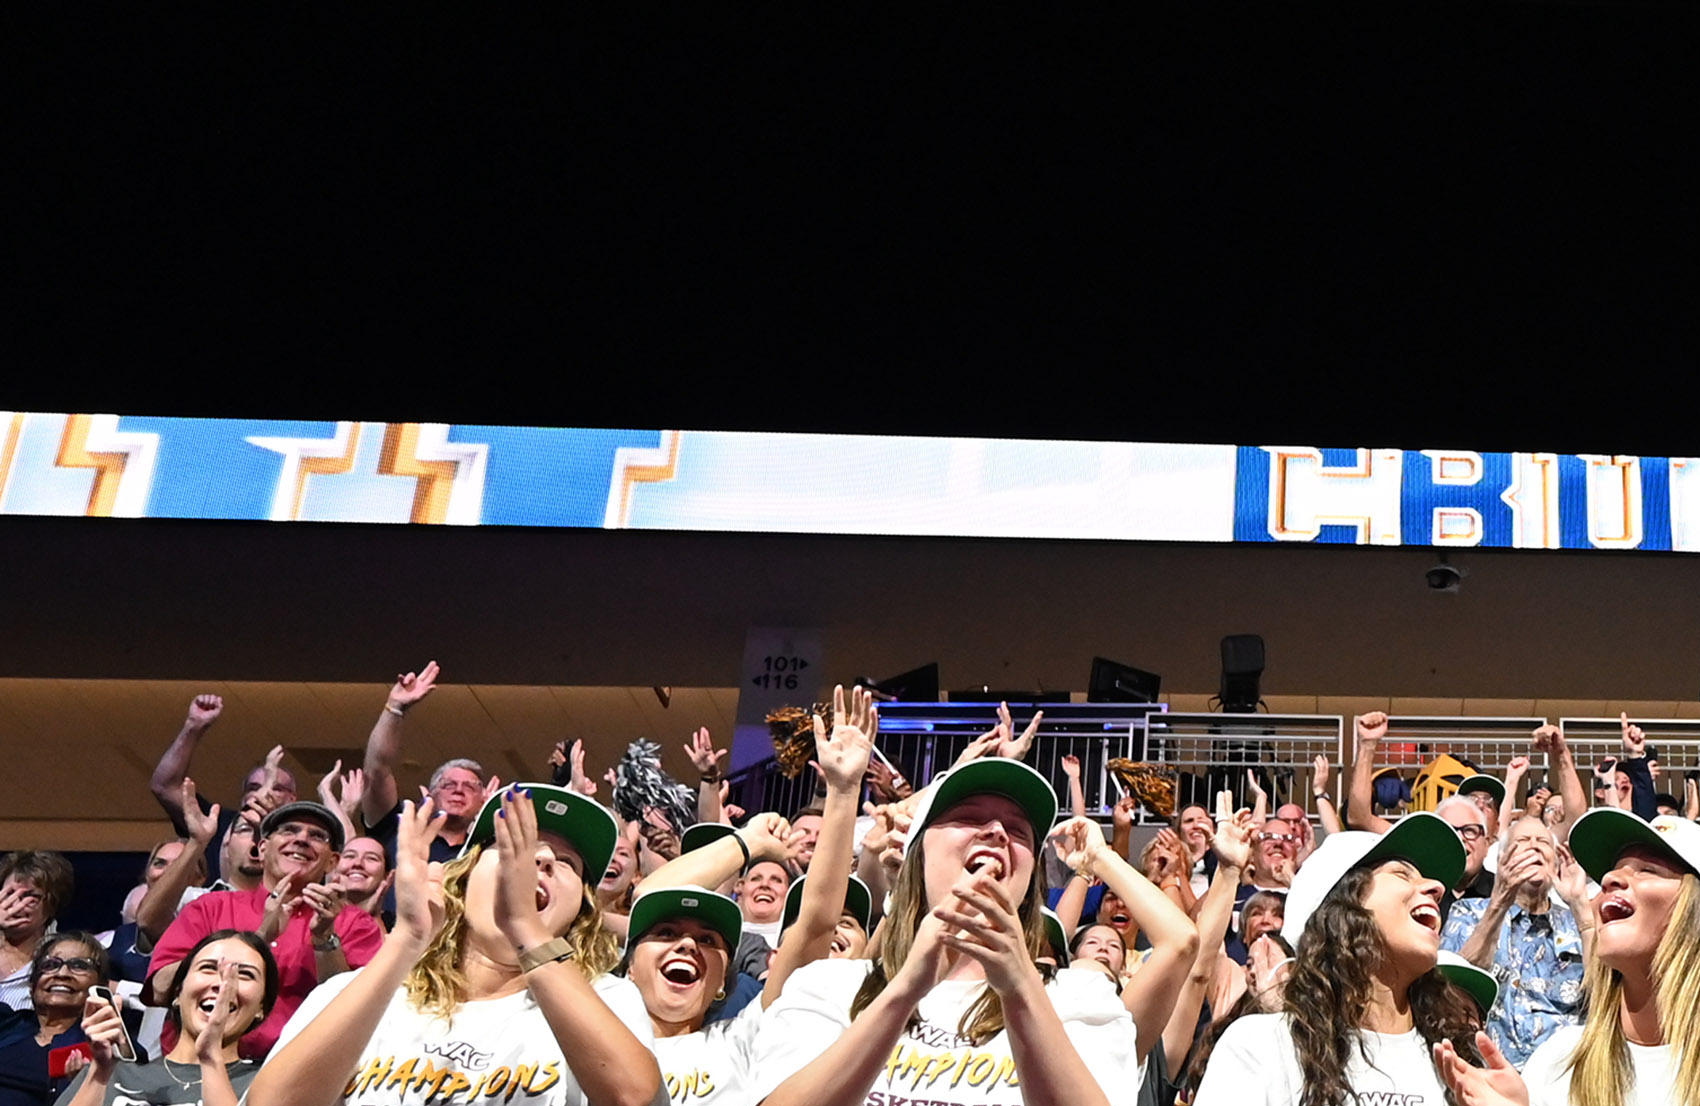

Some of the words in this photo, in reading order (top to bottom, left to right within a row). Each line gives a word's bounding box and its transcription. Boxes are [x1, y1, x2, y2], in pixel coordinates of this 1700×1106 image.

[764, 656, 798, 671] 101
[763, 674, 799, 690] 116
[424, 1041, 494, 1071] WAC
